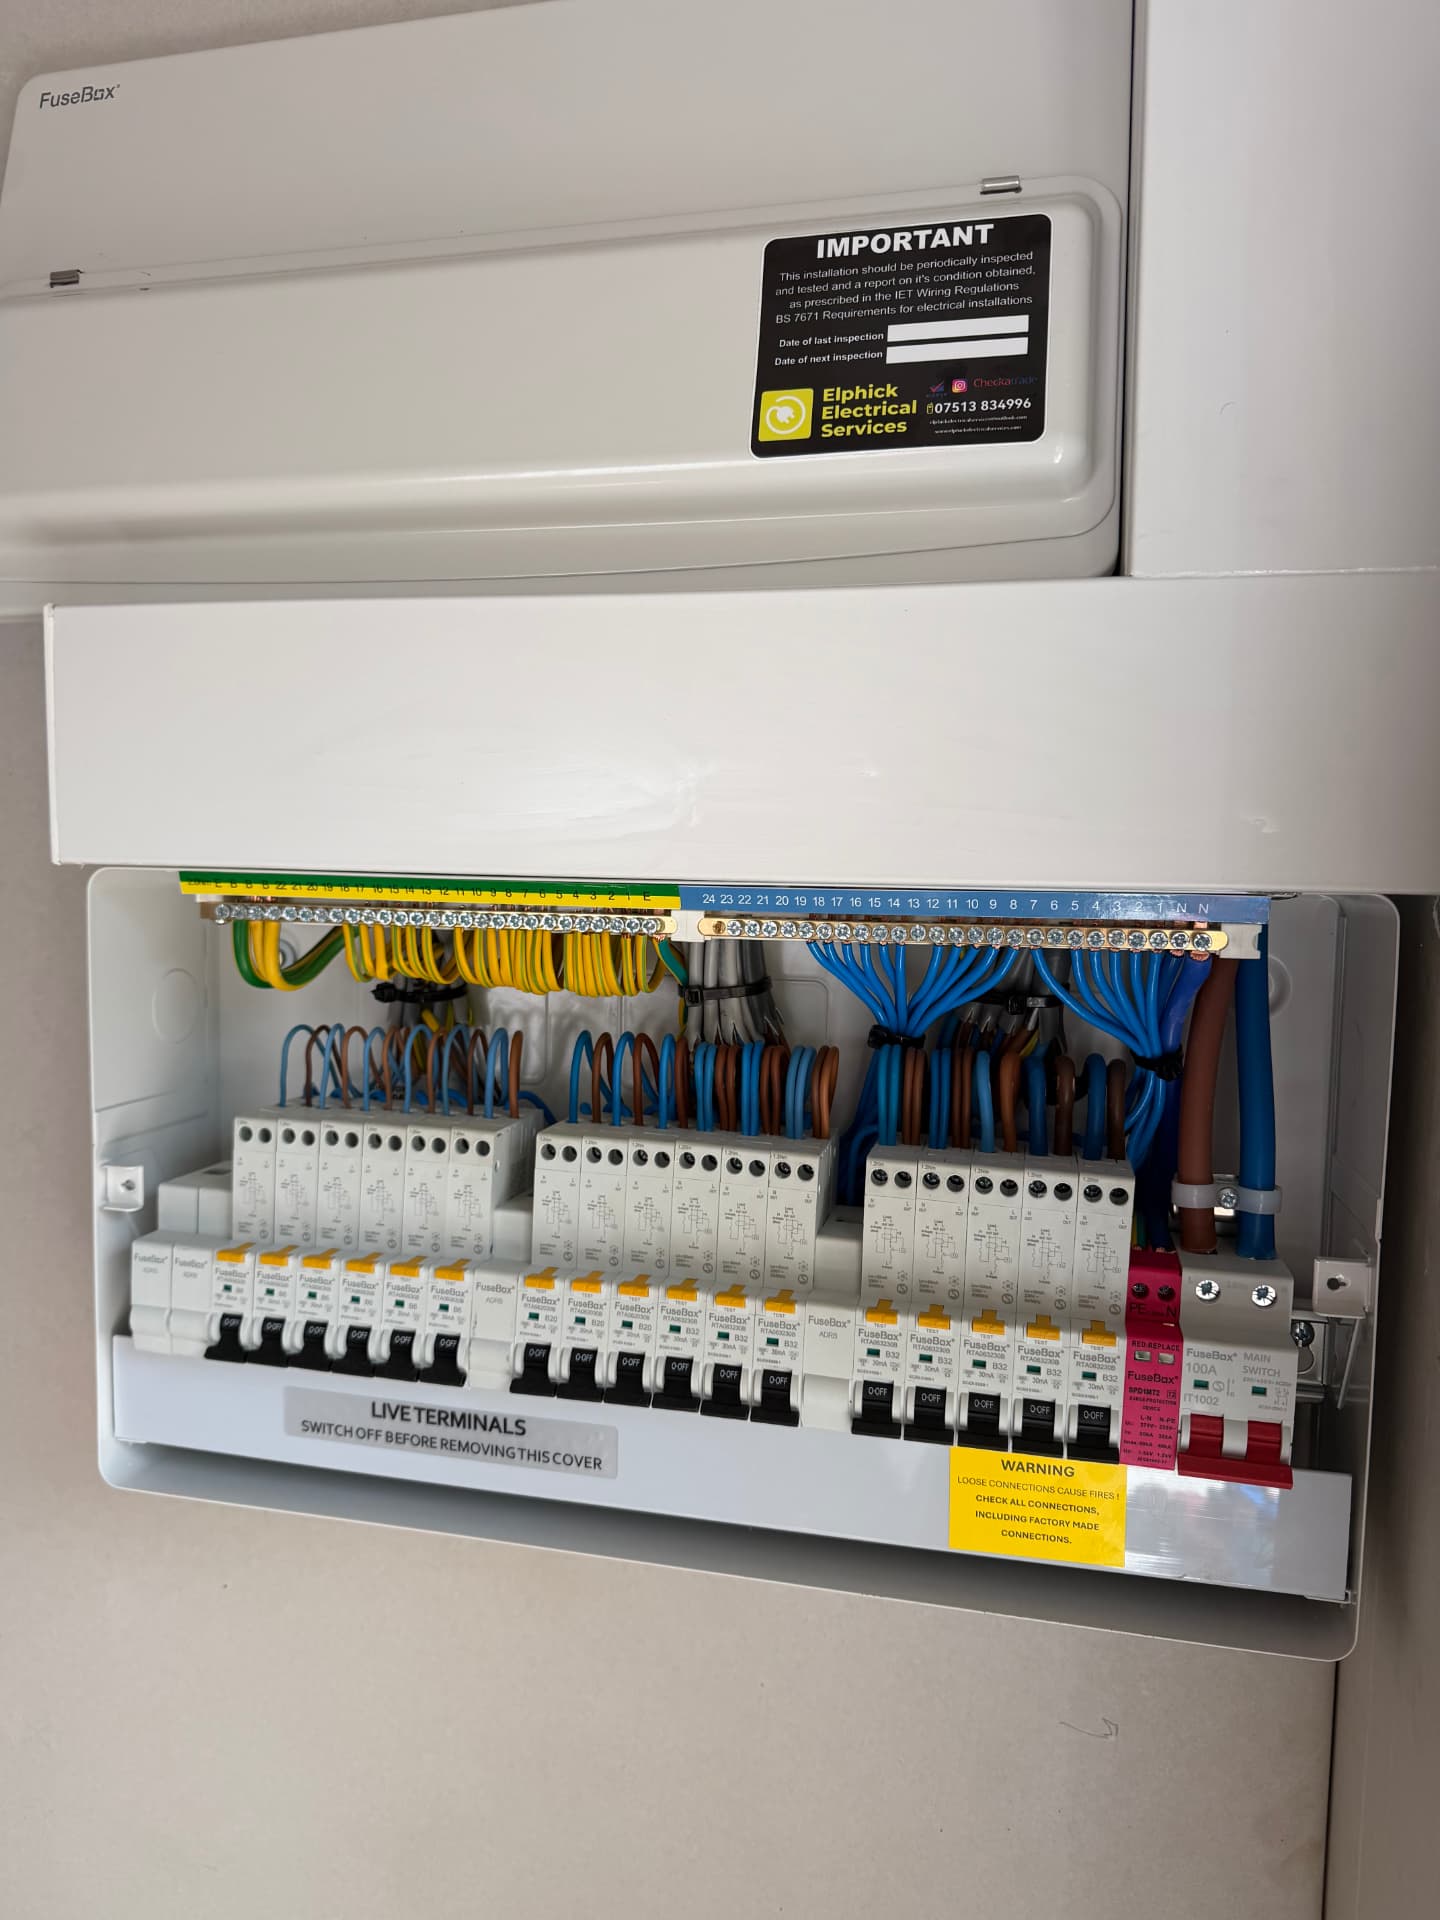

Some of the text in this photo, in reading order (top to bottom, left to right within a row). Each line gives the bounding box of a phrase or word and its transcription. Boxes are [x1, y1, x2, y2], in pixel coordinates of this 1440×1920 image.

[39, 85, 118, 109] FuseBox
[817, 223, 994, 258] IMPORTANT
[780, 251, 1033, 281] This installation should be periodically inspected
[776, 286, 794, 296] and
[798, 283, 828, 294] tested
[832, 281, 851, 291] and
[855, 281, 861, 289] a
[864, 278, 895, 289] report
[899, 277, 912, 285] on
[915, 274, 930, 284] it's
[934, 271, 982, 282] condition
[789, 282, 1020, 309] as prescribed in the IET Wiring Regulations
[776, 296, 1033, 324] BS 7671 Requirements for electrical installations
[779, 332, 884, 348] Date of last inspection
[774, 350, 883, 366] Date of next inspection
[823, 383, 898, 404] Elphick
[821, 399, 917, 420] Electrical
[934, 398, 1032, 414] 07513 834996
[821, 419, 908, 438] Services
[440, 887, 449, 896] 12
[456, 887, 464, 896] 11
[472, 887, 482, 897] 10
[490, 888, 496, 897] 9
[505, 888, 512, 898] 8
[522, 889, 528, 898] 7
[556, 890, 563, 899] 5
[573, 891, 579, 900] 4
[590, 891, 597, 900] 3
[608, 891, 615, 901] 2
[626, 891, 630, 900] 1
[643, 891, 651, 901] E
[702, 894, 1209, 914] 24 23 22 21 20 19 18 17 16 15 14 13 12 11 10 9 8 7 6 5 4 3 2 1 N N
[568, 1298, 605, 1310] FuseBox
[614, 1301, 652, 1314] FuseBox
[1130, 1303, 1177, 1317] PE N
[660, 1305, 700, 1318] FuseBox
[709, 1312, 748, 1325] FuseBox
[758, 1318, 798, 1331] FuseBox
[808, 1315, 848, 1328] FuseBox
[735, 1334, 749, 1343] B32
[858, 1328, 899, 1341] FuseBox
[910, 1334, 952, 1347] FuseBox
[963, 1340, 1007, 1353] FuseBox
[1018, 1345, 1062, 1358] FuseBox
[885, 1350, 900, 1359] B32
[937, 1356, 953, 1366] B32
[1073, 1351, 1118, 1364] FuseBox
[1186, 1347, 1234, 1362] FuseBox
[1243, 1352, 1272, 1363] MAIN
[993, 1362, 1008, 1371] B32
[1046, 1368, 1062, 1377] B32
[1186, 1362, 1218, 1376] 100A
[1242, 1365, 1281, 1377] SWITCH
[1102, 1374, 1119, 1383] B32
[1127, 1370, 1176, 1384] FuseBox
[1183, 1393, 1220, 1406] IT1002
[371, 1401, 527, 1436] LIVE TERMINALS
[301, 1419, 603, 1471] SWITCH OFF BEFORE REMOVING THIS COVER
[1001, 1459, 1075, 1477] WARNING
[957, 1475, 987, 1487] LOOSE
[989, 1479, 1055, 1494] CONNECTIONS
[1057, 1487, 1087, 1498] CAUSE
[1089, 1490, 1115, 1500] FIRES
[975, 1494, 1100, 1515] CHECK ALL CONNECTIONS,
[975, 1510, 1100, 1531] INCLUDING FACTORY MADE
[1001, 1529, 1073, 1544] CONNECTIONS.
